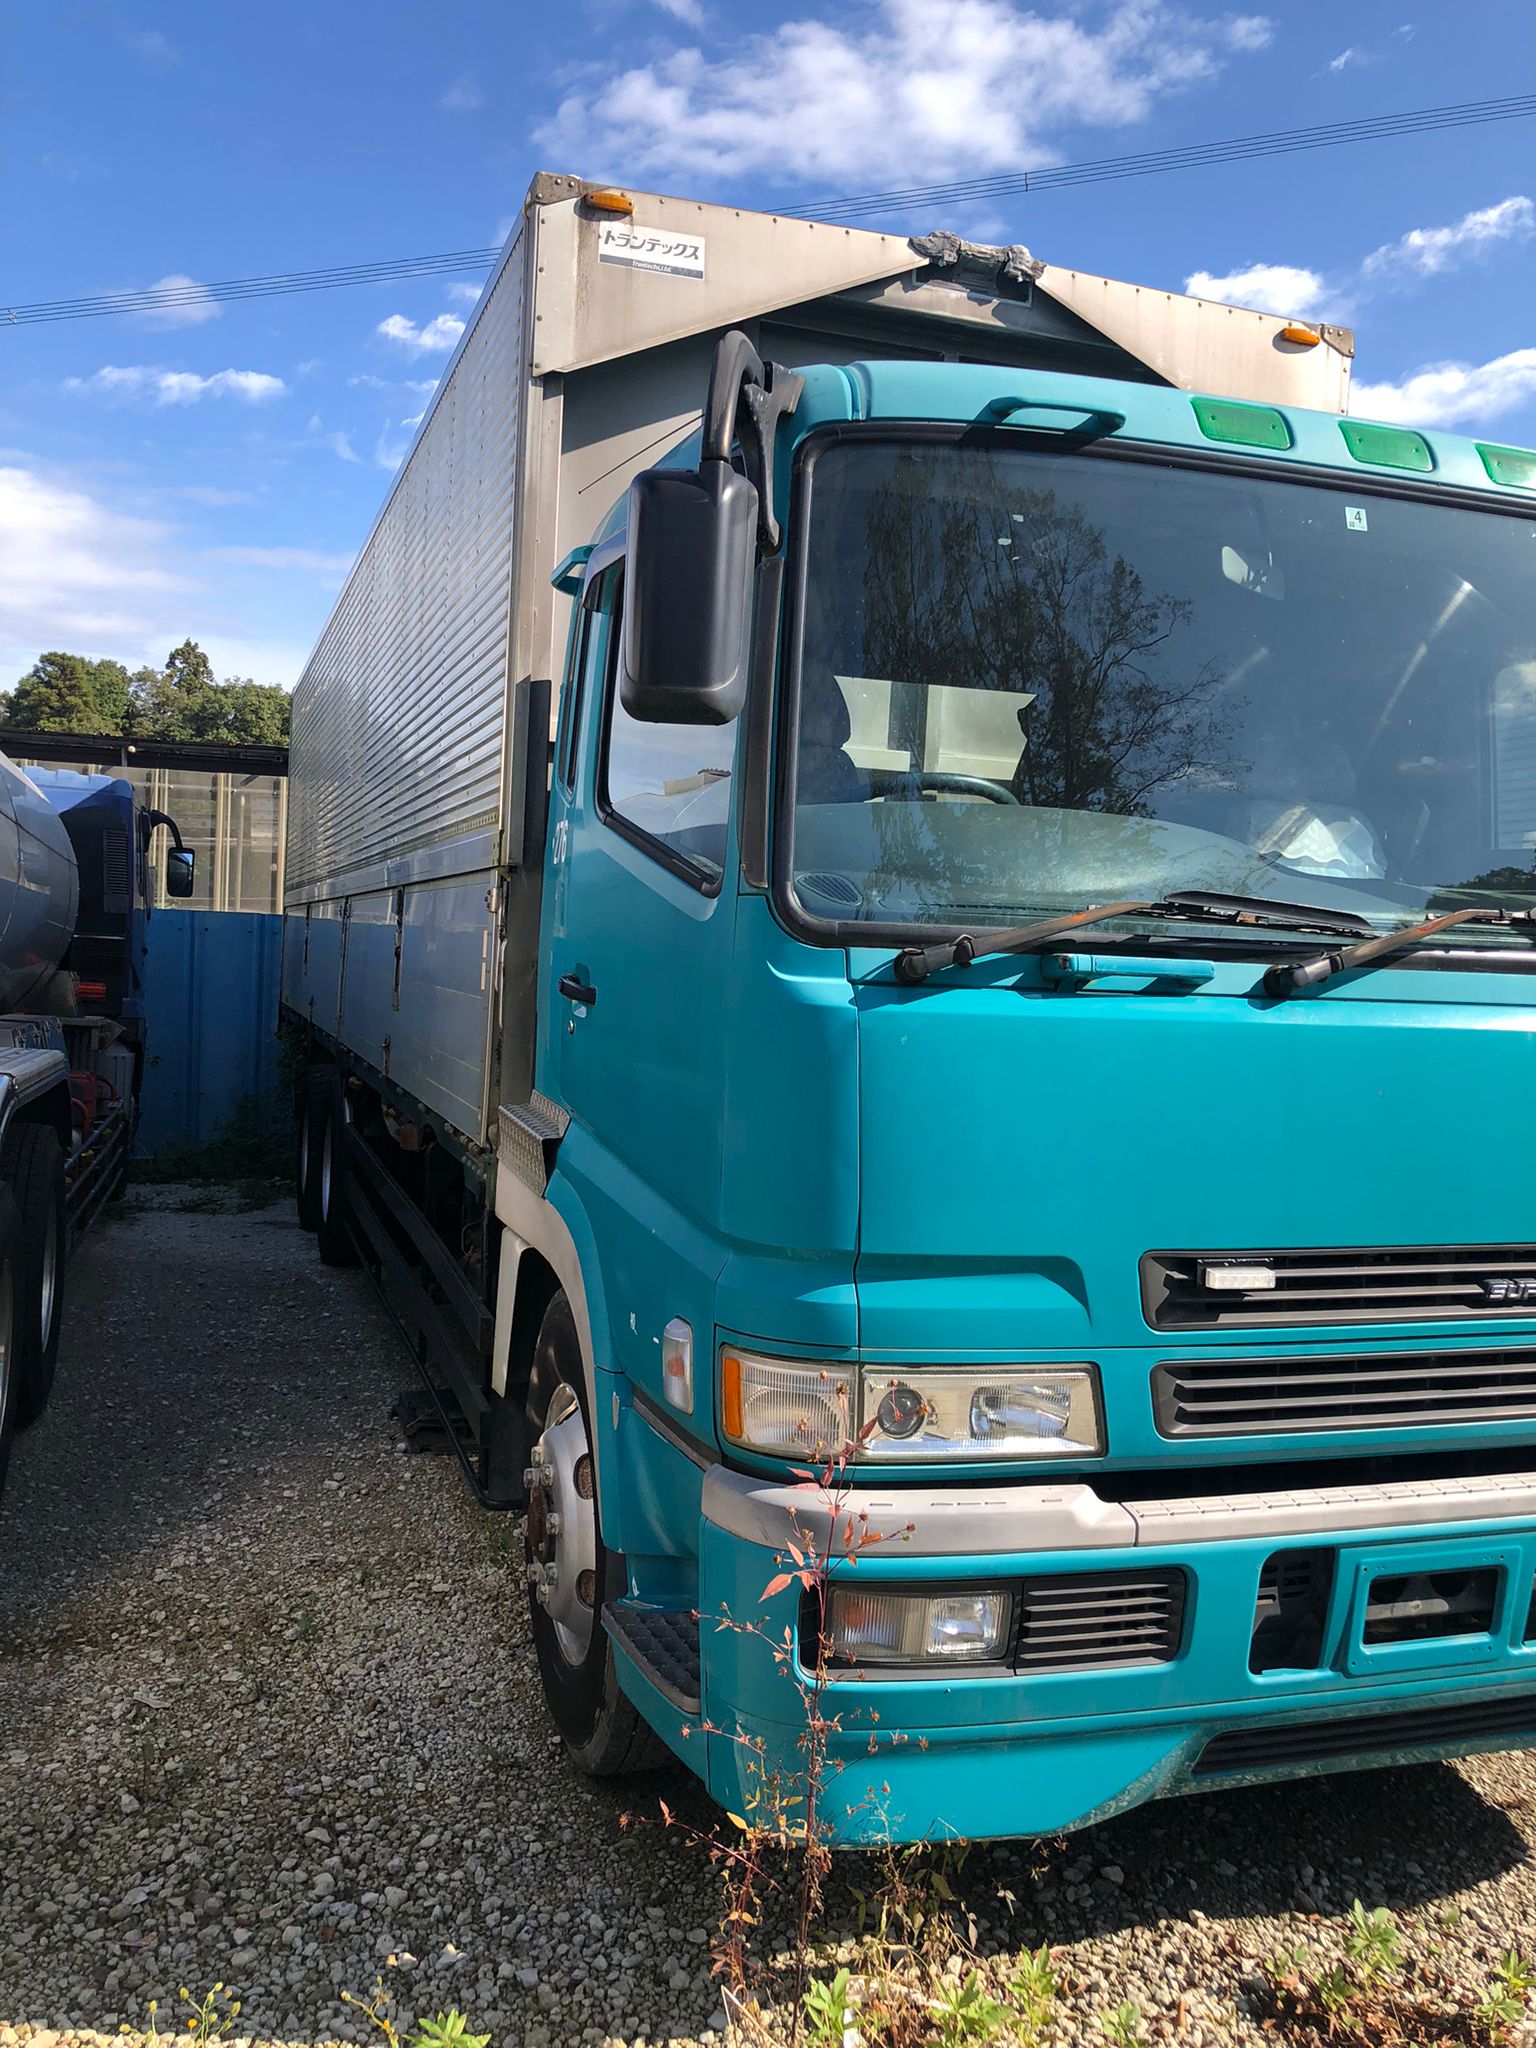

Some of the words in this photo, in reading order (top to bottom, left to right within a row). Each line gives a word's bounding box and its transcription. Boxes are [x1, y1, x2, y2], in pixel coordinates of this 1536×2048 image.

[604, 230, 700, 260] トランテックス
[1354, 510, 1362, 524] 4
